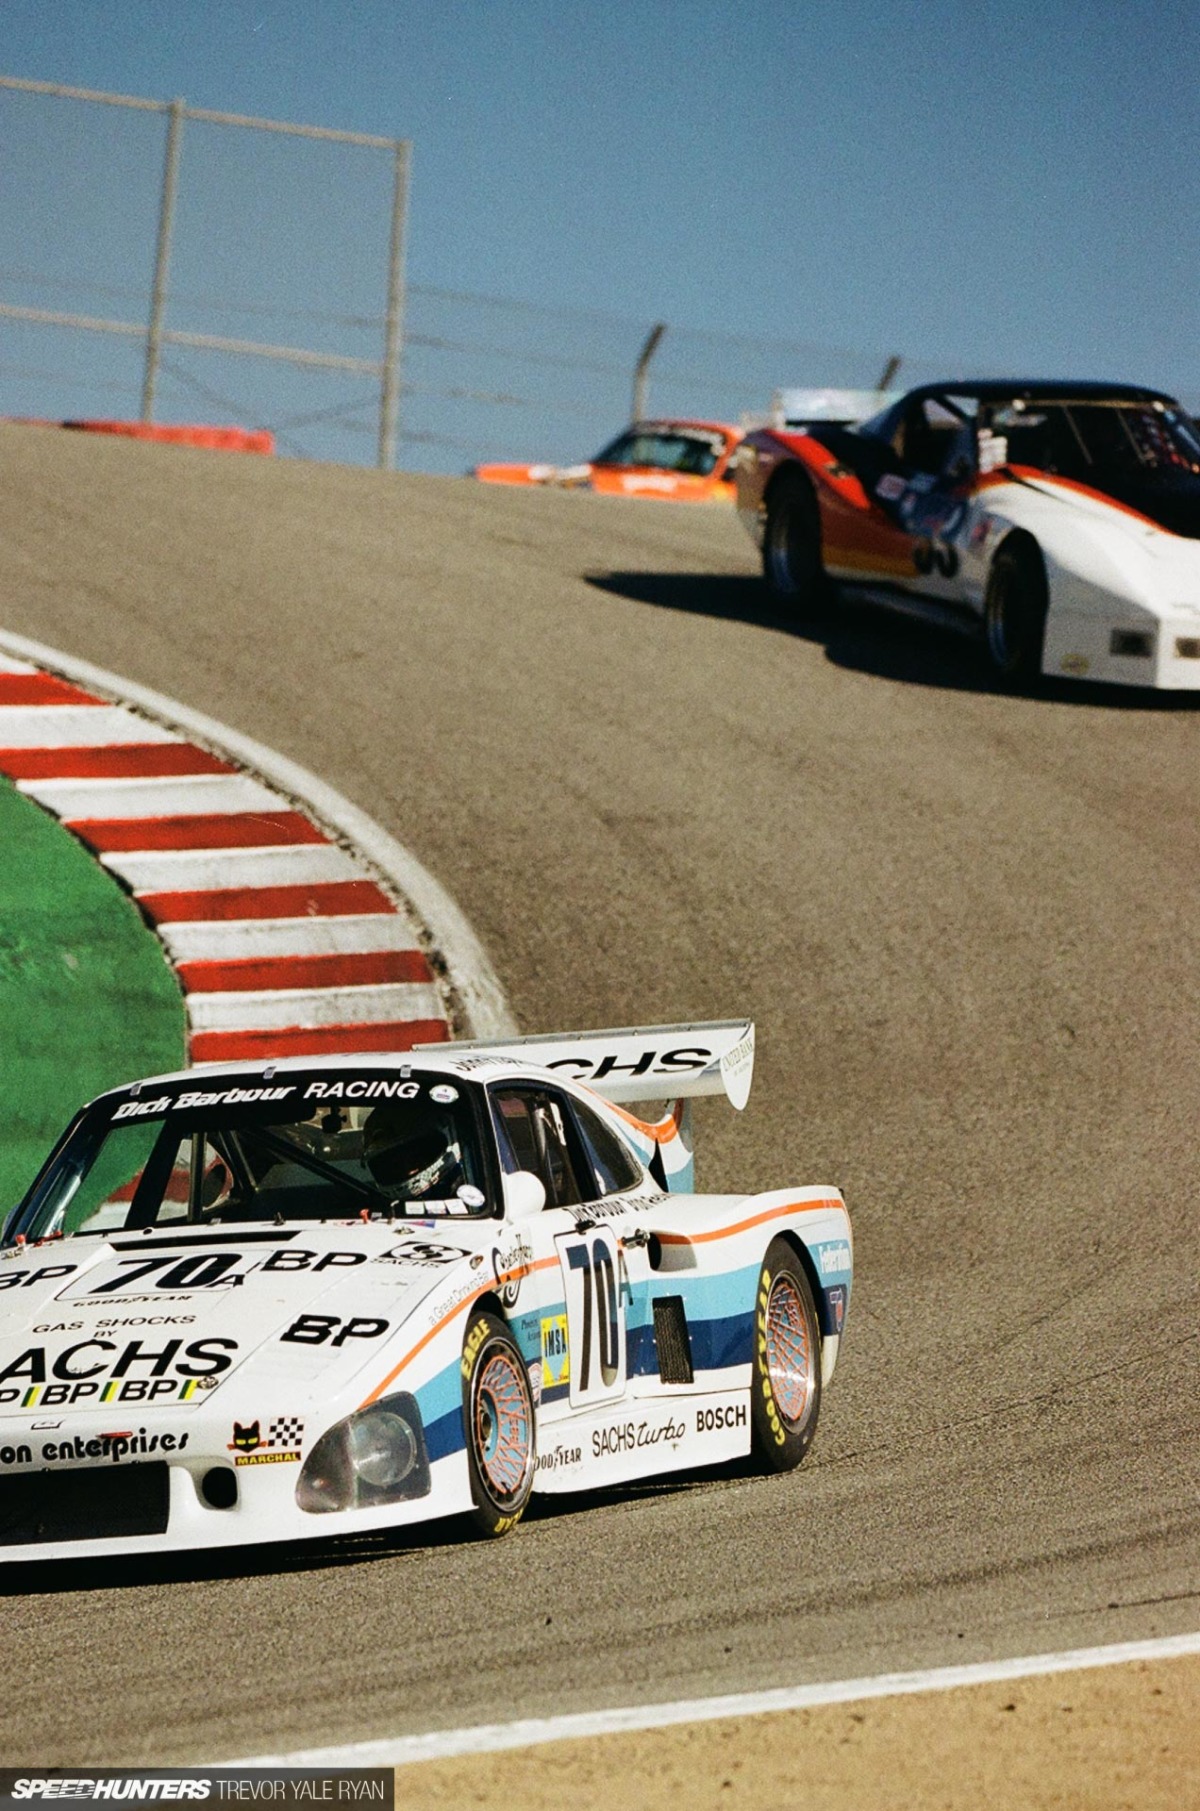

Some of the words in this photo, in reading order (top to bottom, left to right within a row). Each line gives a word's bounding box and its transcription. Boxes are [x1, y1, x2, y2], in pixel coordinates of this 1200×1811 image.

[545, 1048, 712, 1080] CHS
[172, 1086, 297, 1110] Barbour
[303, 1081, 420, 1099] RACING
[260, 1250, 368, 1272] BP
[32, 1321, 83, 1334] GAS
[95, 1315, 198, 1329] SHOCKS
[93, 1330, 117, 1338] BY
[280, 1314, 390, 1347] BP
[543, 1327, 567, 1358] IMSA
[0, 1339, 239, 1384] ACHS
[0, 1388, 21, 1404] P
[40, 1382, 99, 1406] BP
[118, 1379, 178, 1401] BP
[0, 1445, 32, 1464] on
[42, 1427, 189, 1462] enterprises
[534, 1446, 581, 1471] OODYEAR
[592, 1422, 635, 1457] SACHS
[697, 1405, 746, 1432] BOSCH
[237, 1452, 299, 1466] MARCHAL
